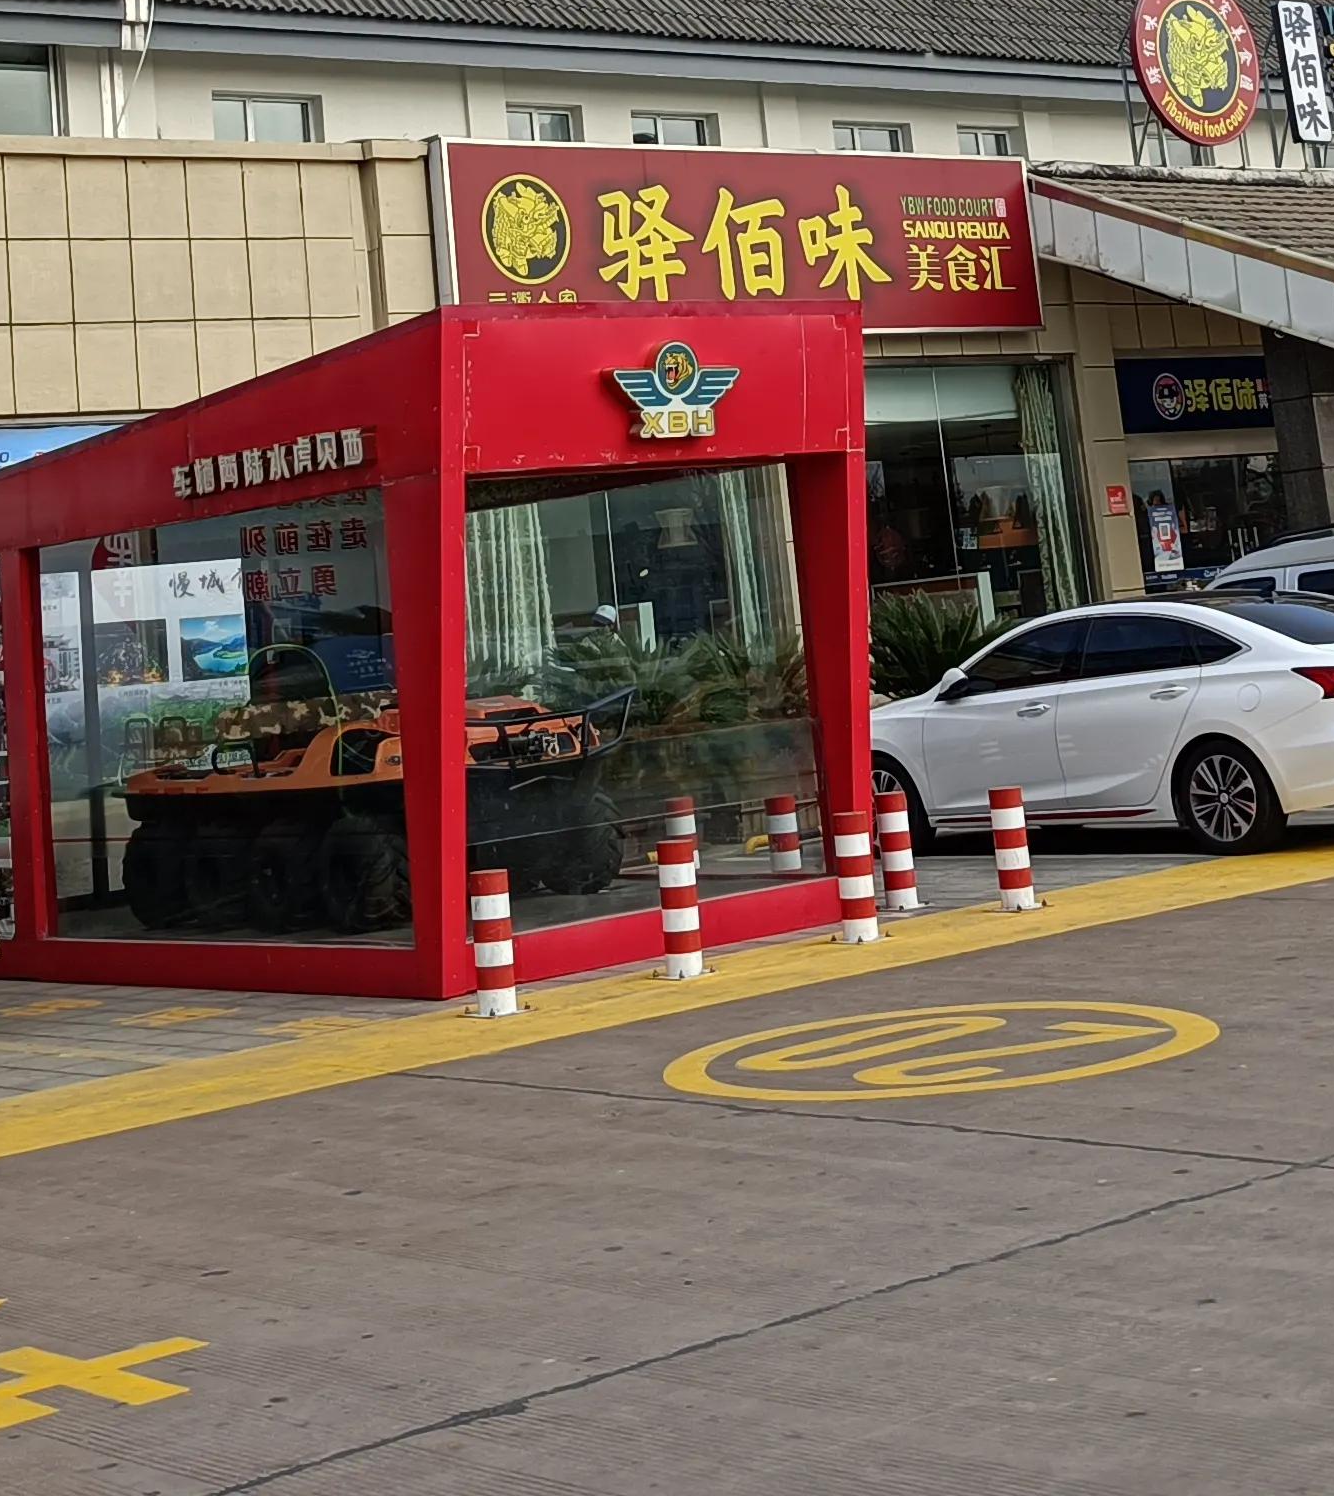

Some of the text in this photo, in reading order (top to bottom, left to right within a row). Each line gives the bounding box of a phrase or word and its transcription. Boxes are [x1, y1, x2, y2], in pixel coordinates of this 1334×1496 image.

[1281, 5, 1329, 138] 驿佰味
[1204, 117, 1227, 138] food
[1225, 98, 1249, 131] court
[900, 196, 926, 215] YBW
[926, 196, 957, 217] FOOD
[958, 197, 994, 217] COURT
[597, 184, 893, 302] 驿佰味
[905, 243, 1017, 292] 美食汇
[642, 409, 714, 435] XBH
[168, 567, 241, 599] 慢城
